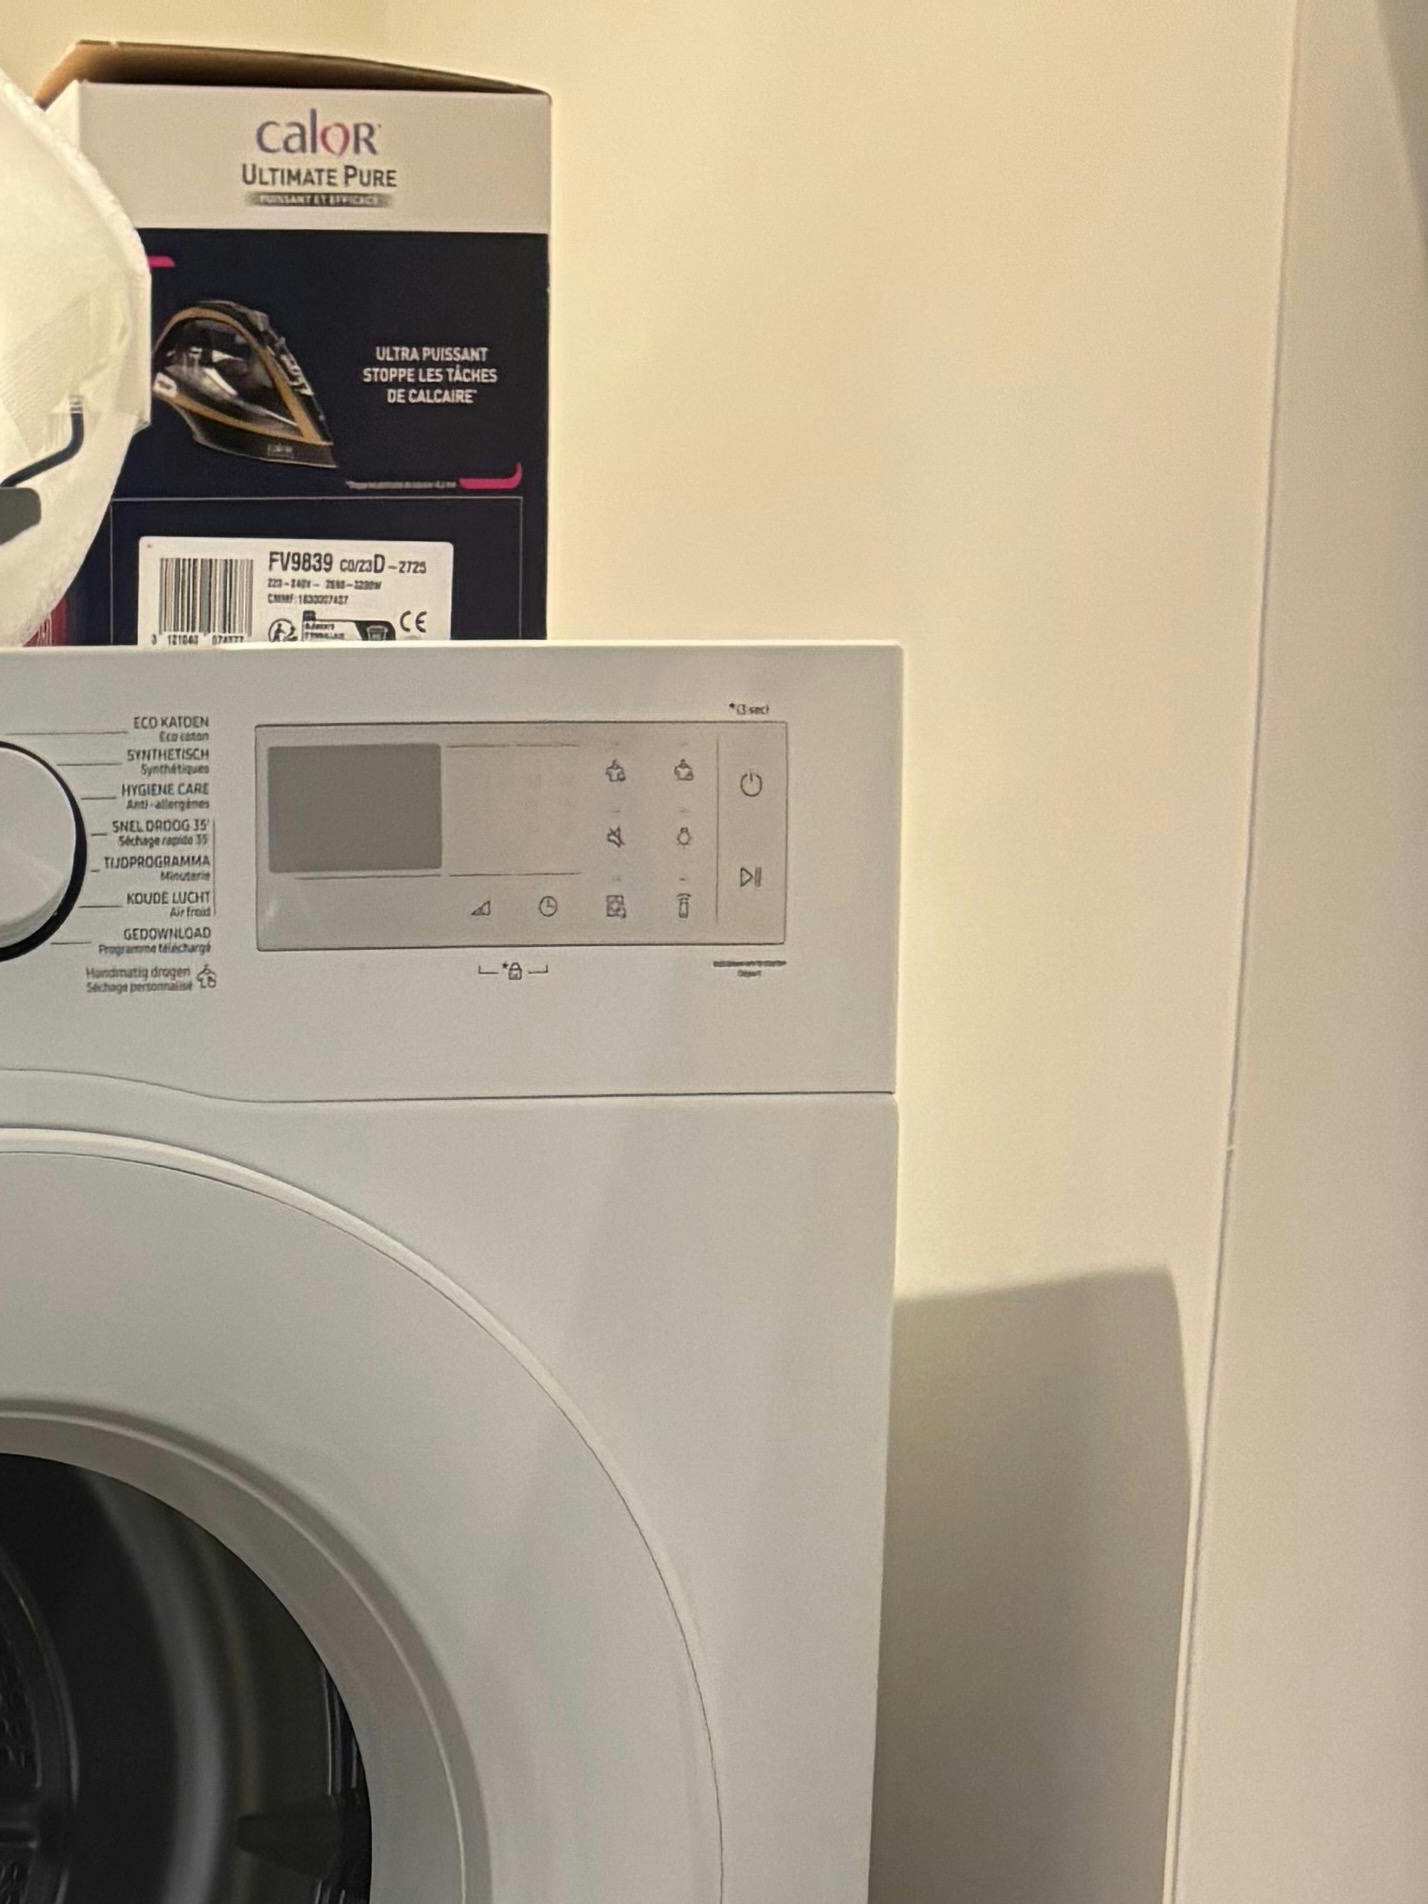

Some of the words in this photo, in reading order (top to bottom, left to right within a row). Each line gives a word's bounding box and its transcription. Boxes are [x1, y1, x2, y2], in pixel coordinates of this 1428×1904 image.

[241, 163, 338, 187] ULTIMATE
[343, 165, 398, 187] PURE
[375, 346, 420, 362] ULTRA
[422, 346, 489, 362] PUISSANT
[362, 367, 415, 383] STOPPE
[418, 367, 443, 383] LES
[445, 363, 498, 383] TÂCHES
[387, 388, 406, 404] DE
[268, 551, 333, 573] FV9839
[133, 716, 158, 729] ECO
[160, 715, 210, 728] KATOEN
[126, 747, 210, 762] SYNTHETISCH
[121, 783, 175, 797] HYGIENE
[177, 783, 210, 796] CARE
[112, 820, 144, 833] SNEL
[145, 819, 190, 833] DROOG
[104, 855, 211, 869] TIJDPROGRAMMA
[126, 892, 169, 905] KOUDE
[172, 891, 211, 904] LUCHT
[123, 926, 212, 941] GEDOWNLOAD
